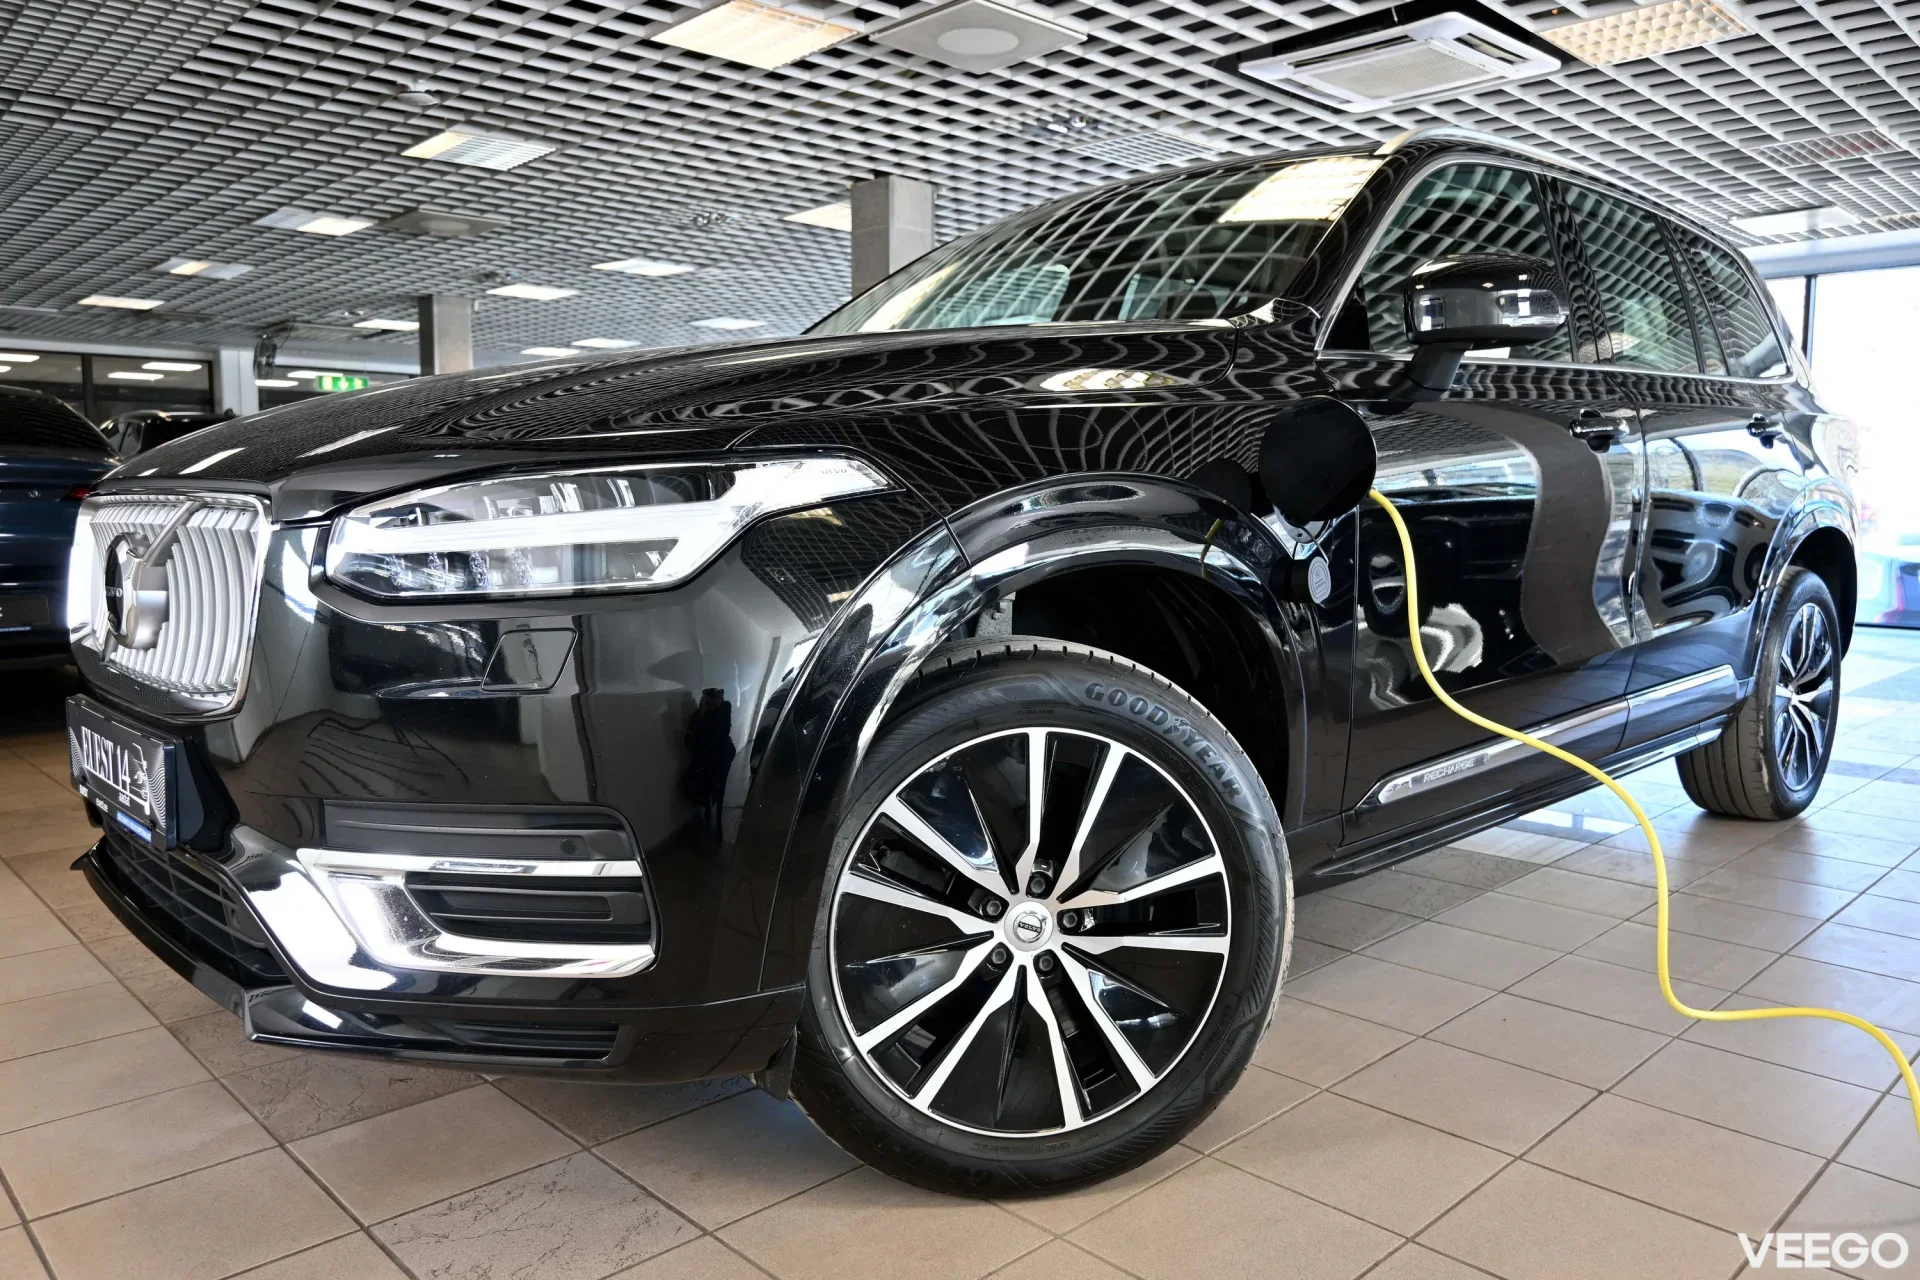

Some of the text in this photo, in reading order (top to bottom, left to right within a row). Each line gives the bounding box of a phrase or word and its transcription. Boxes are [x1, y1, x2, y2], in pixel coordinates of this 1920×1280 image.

[1084, 683, 1244, 799] GOODYEAR
[117, 745, 131, 794] 14
[1423, 758, 1475, 783] RECHARGE
[1019, 922, 1041, 933] VOLVO
